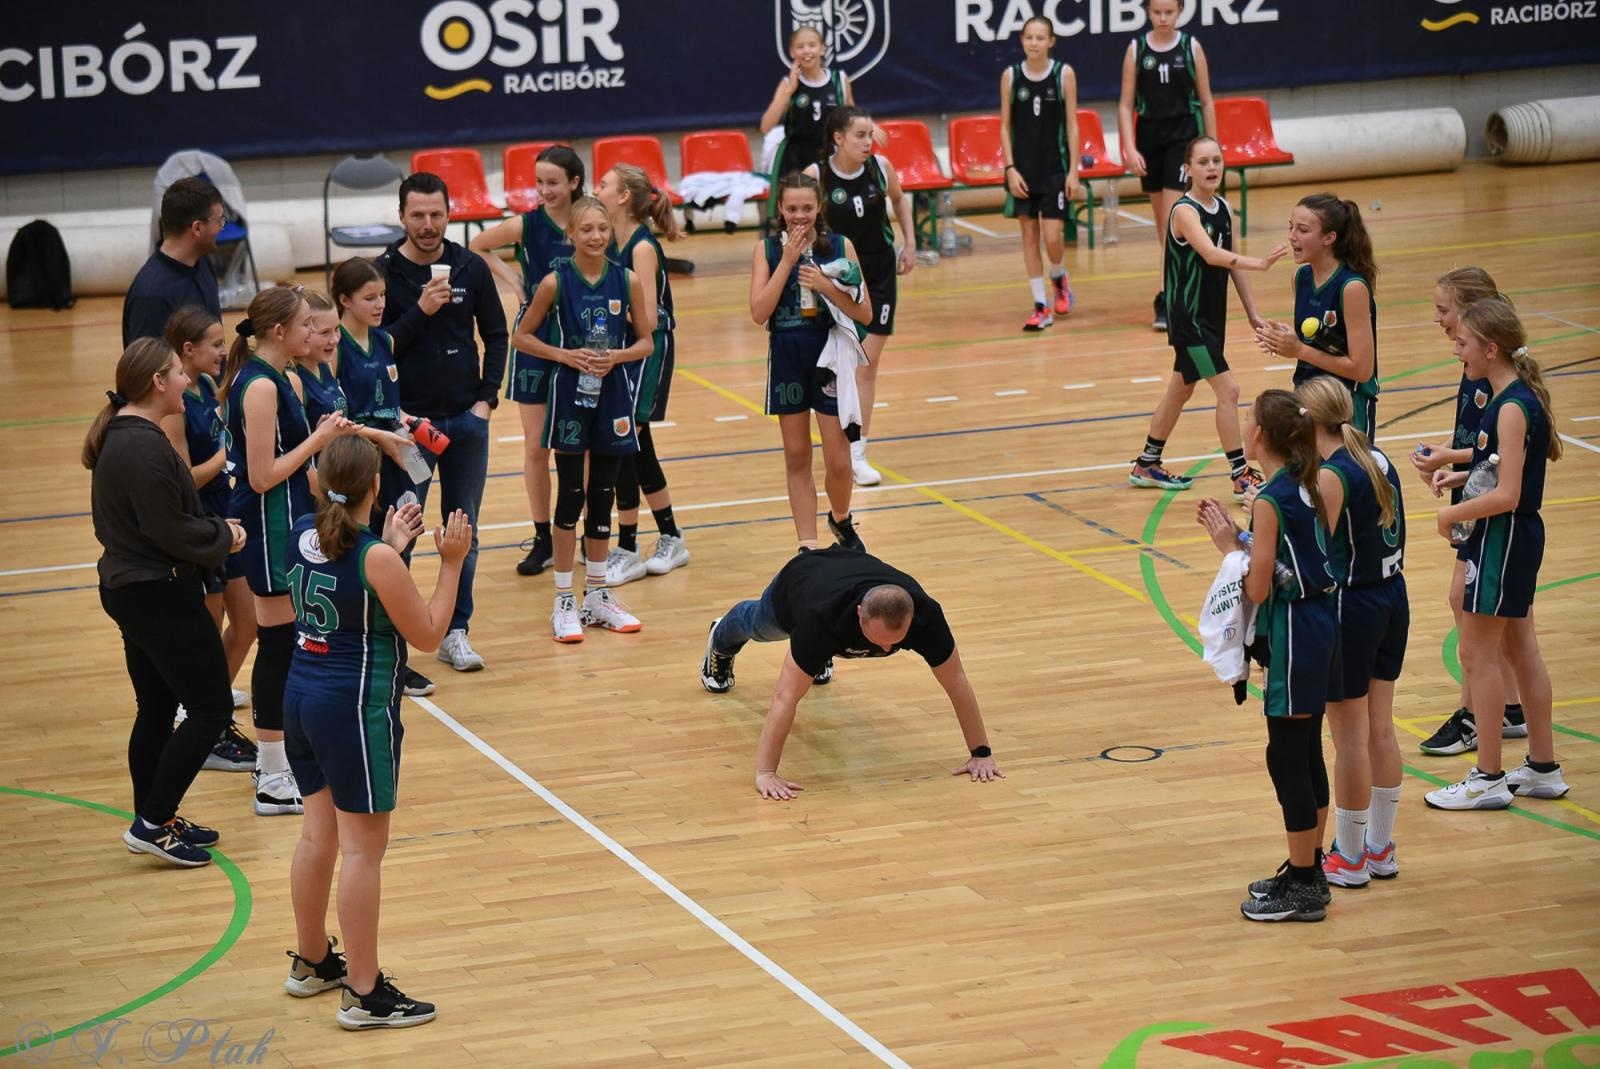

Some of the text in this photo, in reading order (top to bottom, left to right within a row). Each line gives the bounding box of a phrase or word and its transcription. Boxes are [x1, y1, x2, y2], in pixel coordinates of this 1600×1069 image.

[1490, 0, 1597, 25] RACIBÓRZ
[504, 65, 625, 94] RACIBÓRZ
[1158, 62, 1170, 84] 11
[812, 101, 821, 121] 3
[853, 196, 864, 218] 8
[880, 304, 890, 325] 8
[518, 369, 544, 393] 17
[775, 382, 804, 407] 10
[557, 419, 582, 445] 12
[286, 563, 340, 634] 15
